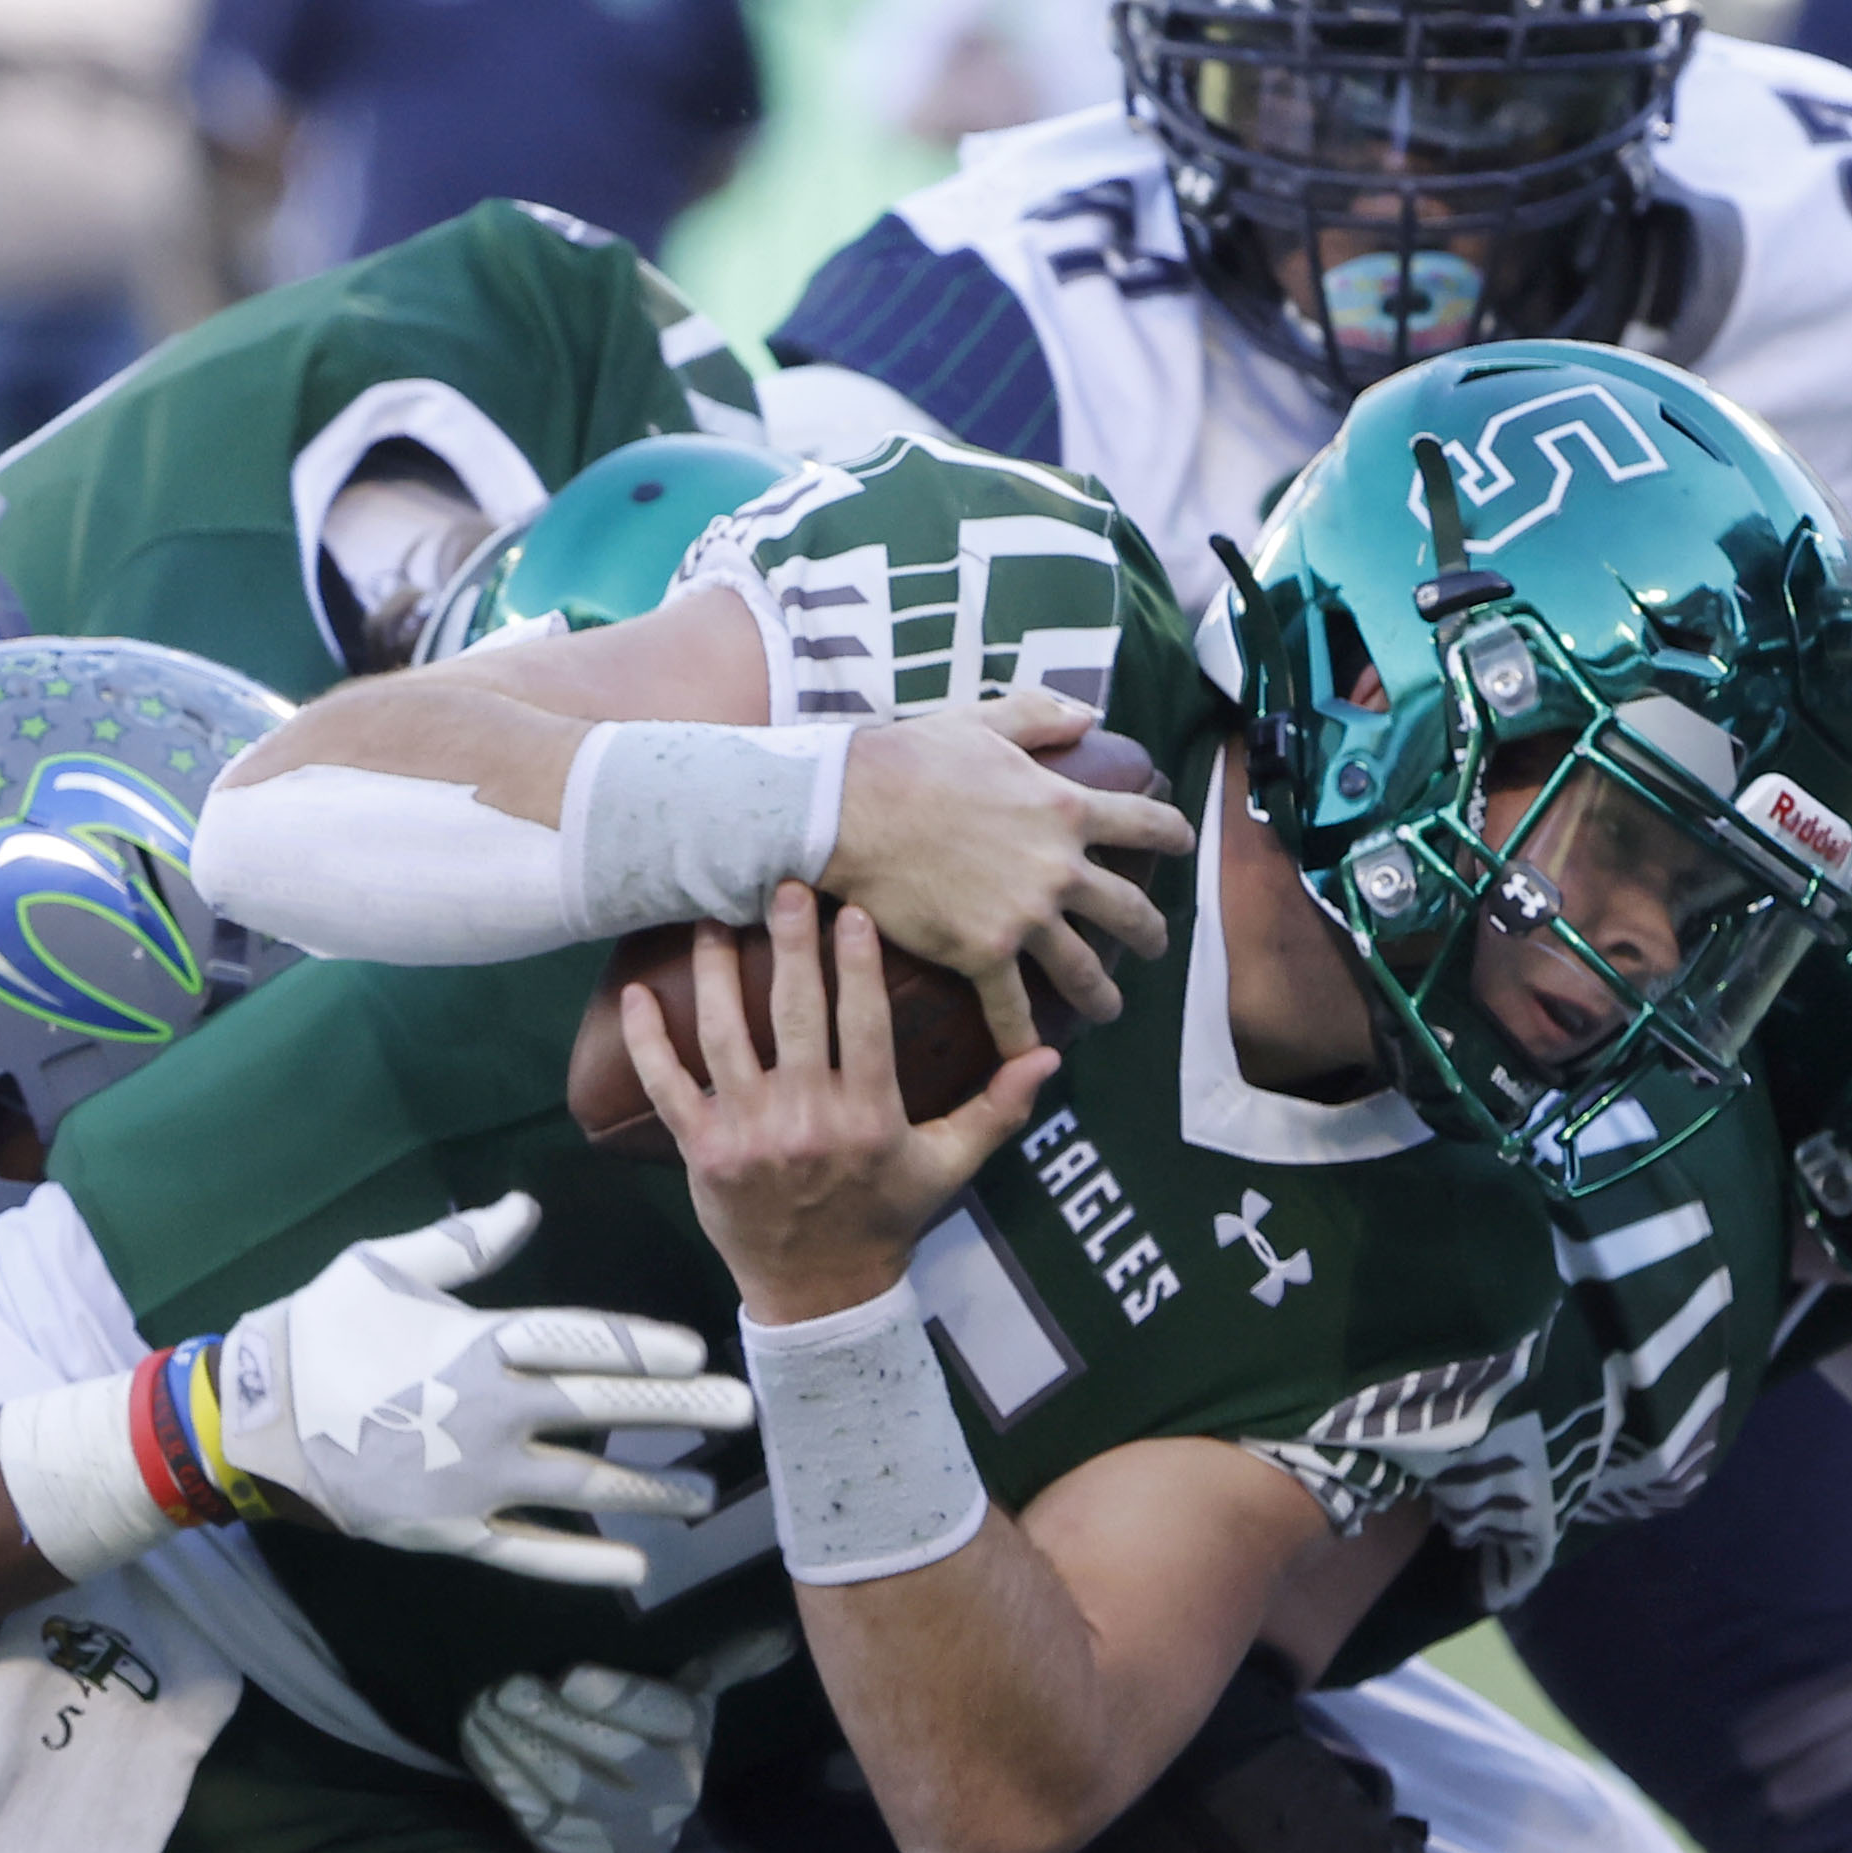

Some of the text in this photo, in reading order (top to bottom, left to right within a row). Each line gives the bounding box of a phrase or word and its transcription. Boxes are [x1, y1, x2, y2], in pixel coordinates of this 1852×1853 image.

[1410, 385, 1668, 553] 5
[1021, 1107, 1181, 1329] EAGLES
[40, 1703, 88, 1752] 5
